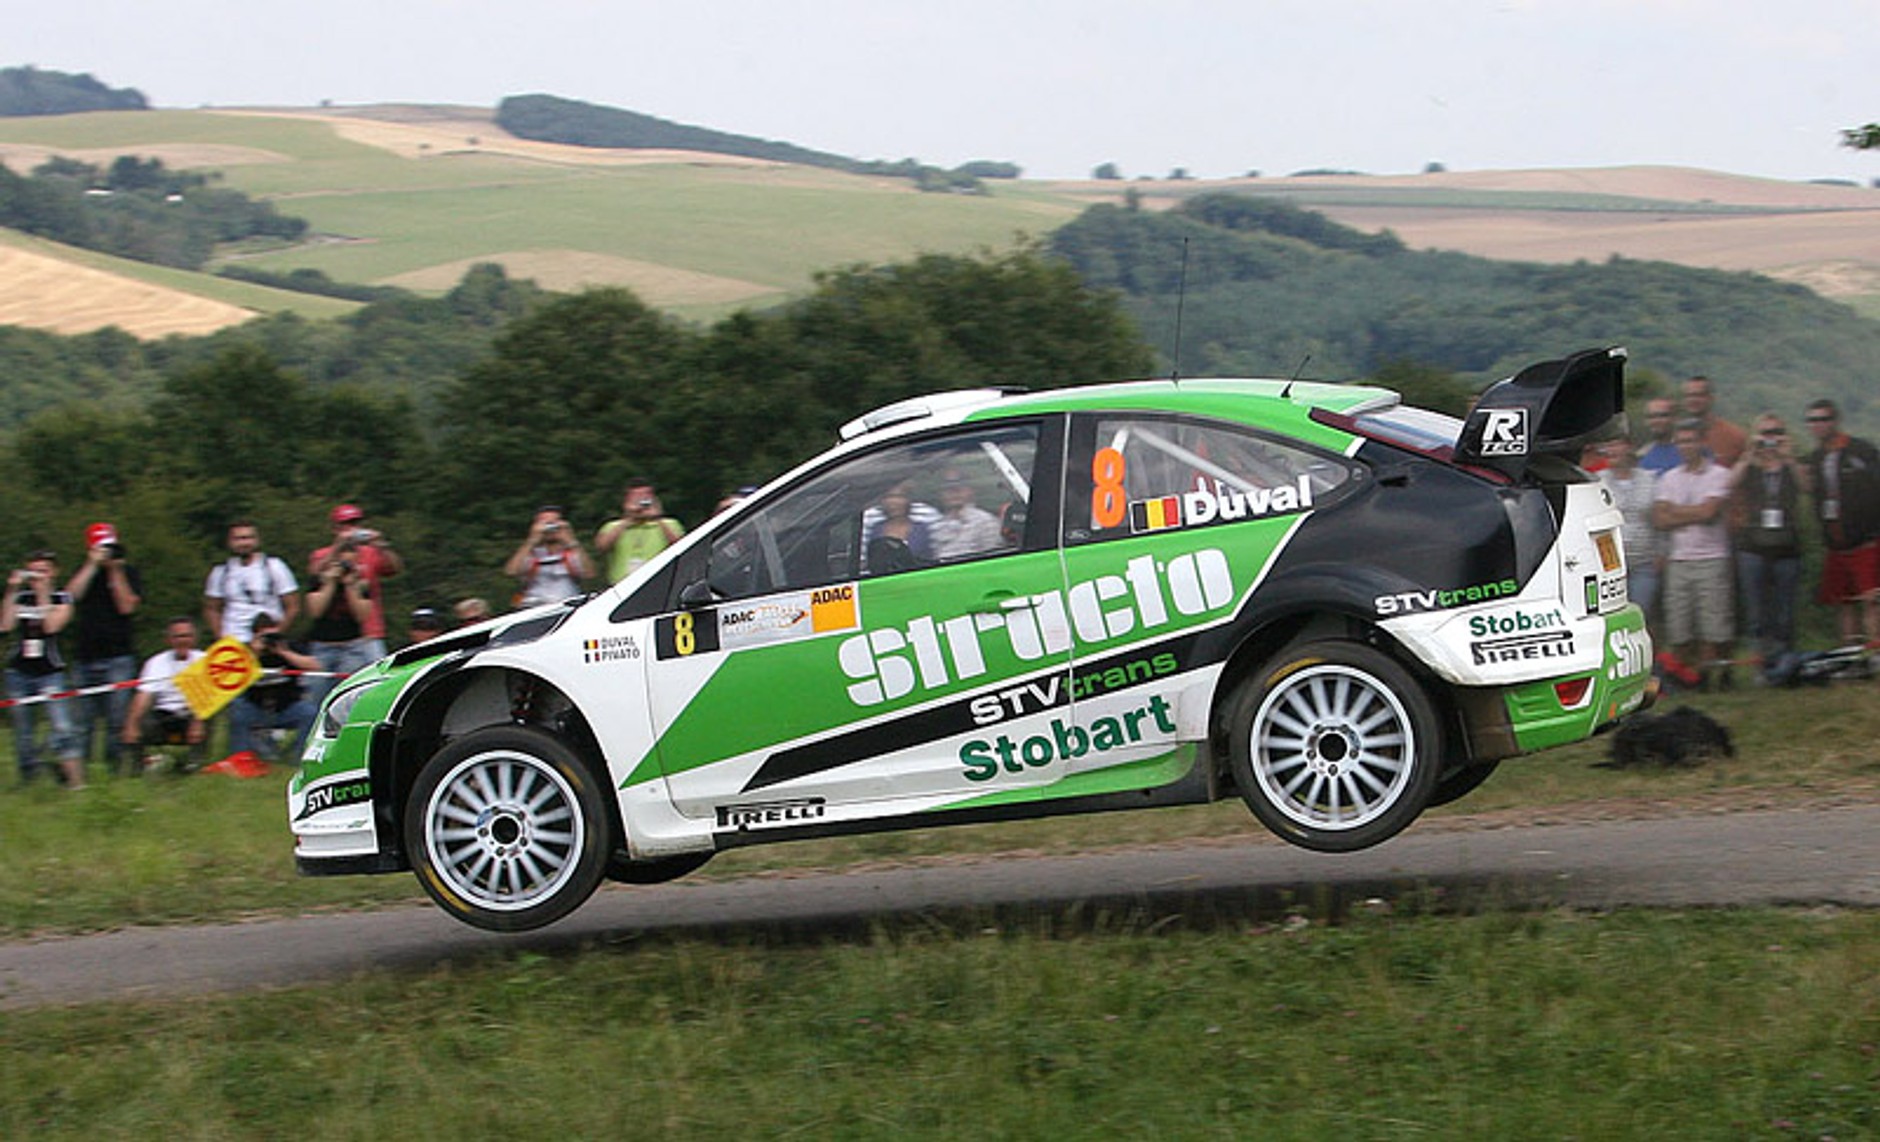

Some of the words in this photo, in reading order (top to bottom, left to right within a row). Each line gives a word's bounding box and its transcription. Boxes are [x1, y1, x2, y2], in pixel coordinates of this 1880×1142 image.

[1092, 447, 1126, 528] 8
[1184, 474, 1313, 526] Duval
[812, 586, 852, 605] ADAC
[1374, 579, 1518, 615] STVtrans
[674, 611, 695, 656] 8
[722, 610, 755, 626] ADAC
[1469, 608, 1567, 637] Stobart
[601, 636, 636, 649] DUVAL
[1470, 630, 1576, 666] PIRELLI
[970, 652, 1178, 725] STVtrans
[959, 695, 1177, 782] Stobart
[714, 796, 826, 828] PIRELLI
